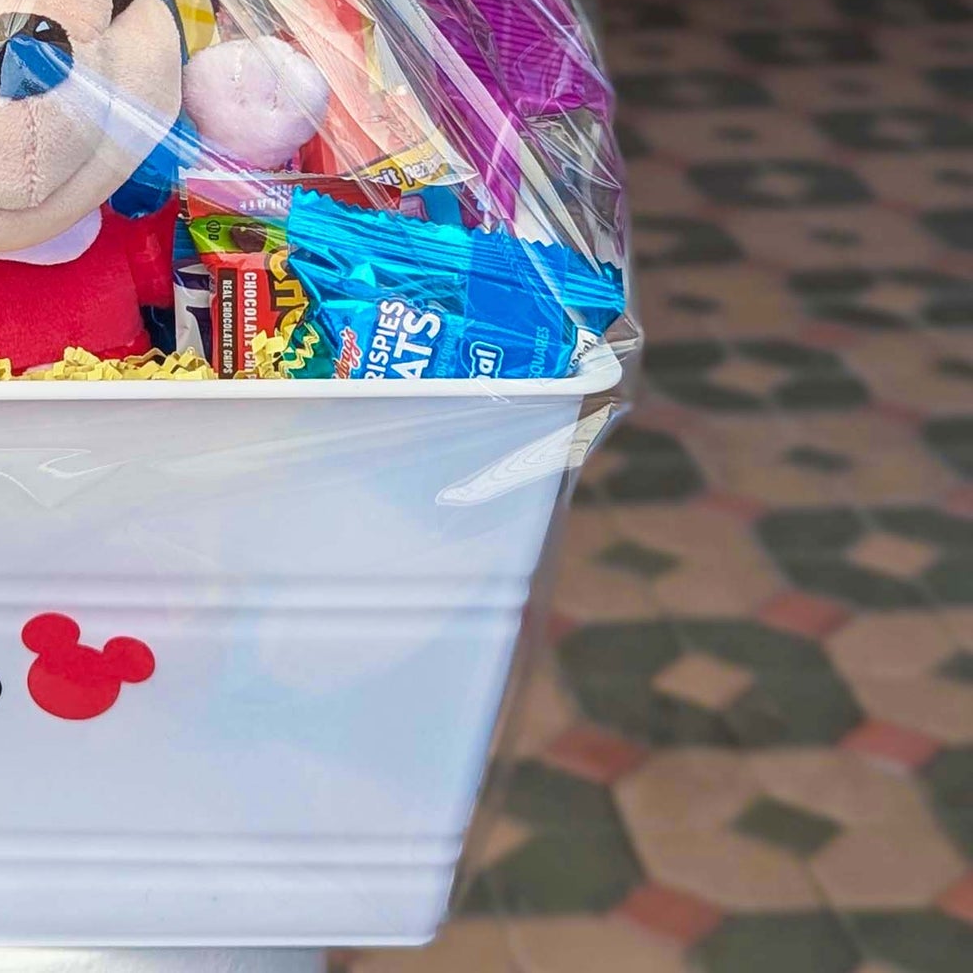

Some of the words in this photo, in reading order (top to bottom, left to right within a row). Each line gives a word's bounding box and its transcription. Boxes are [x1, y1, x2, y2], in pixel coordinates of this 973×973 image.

[222, 279, 232, 299] REAL
[222, 302, 232, 347] CHOCOLATE
[243, 272, 257, 346] CHOCOLATE
[222, 350, 232, 374] CHIPS
[391, 311, 441, 379] ATS
[475, 348, 497, 379] al
